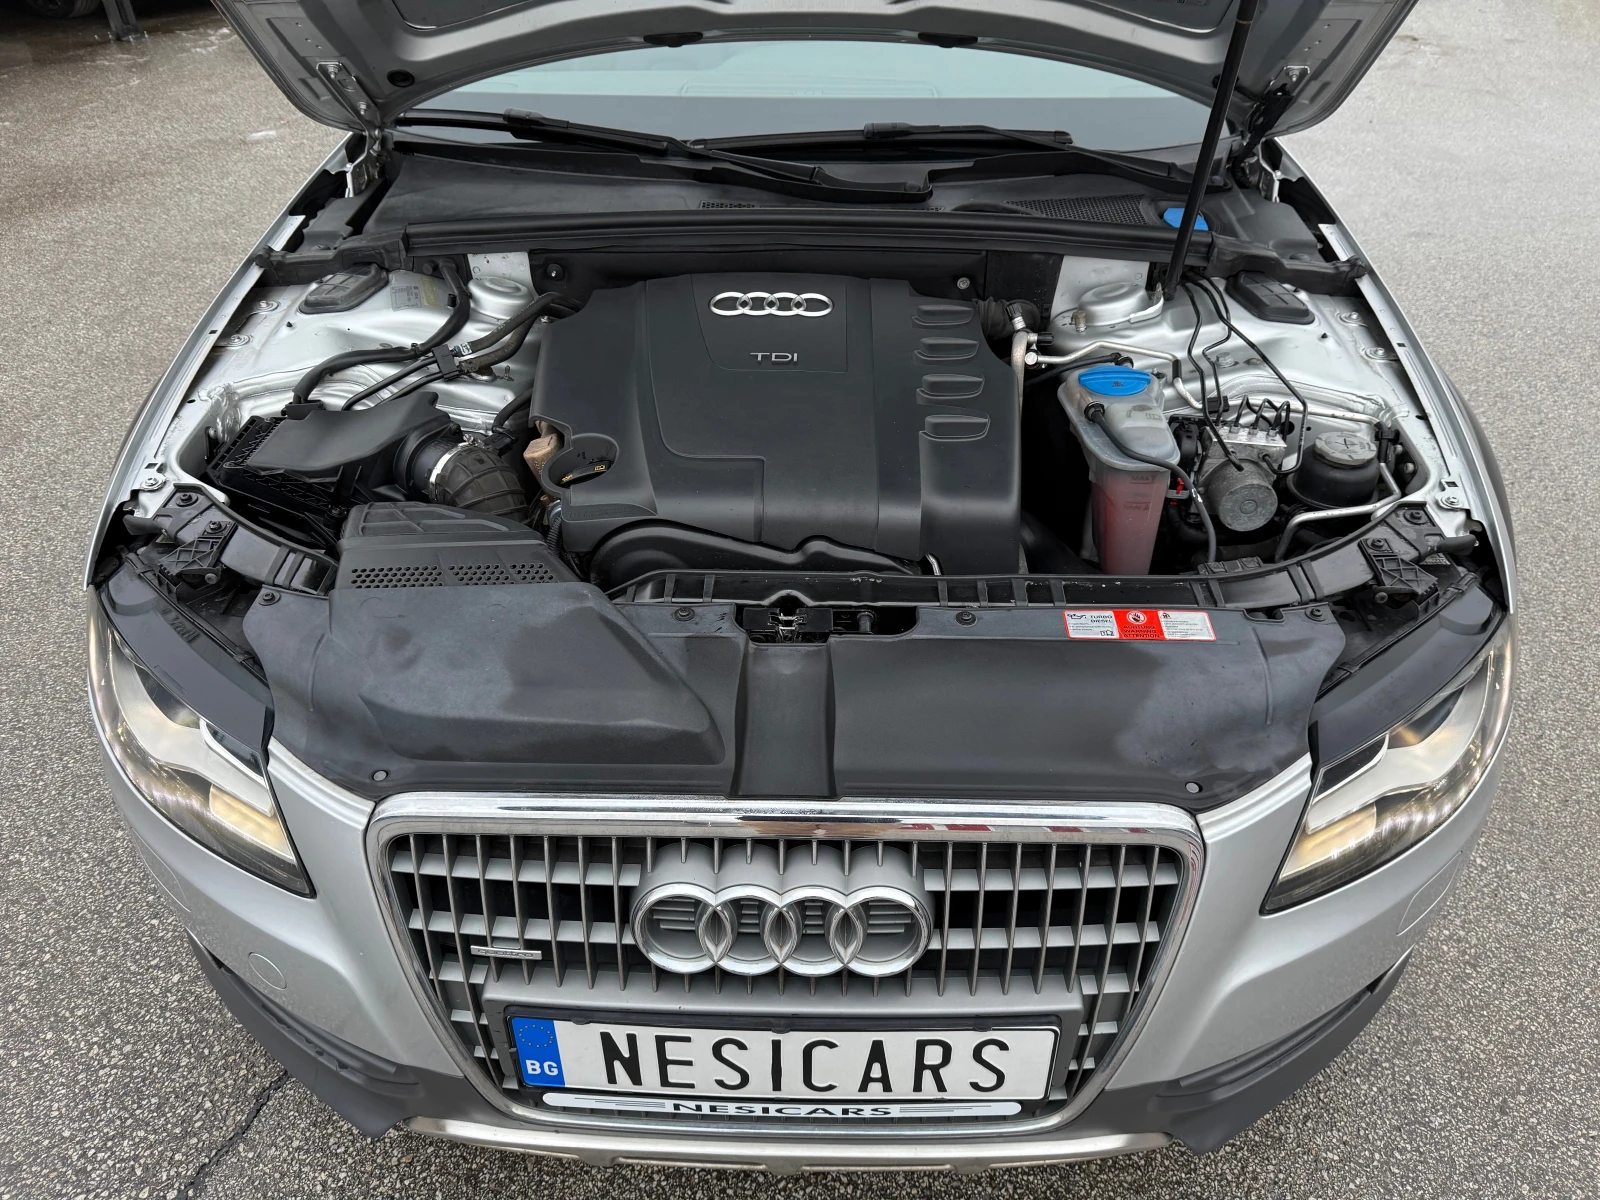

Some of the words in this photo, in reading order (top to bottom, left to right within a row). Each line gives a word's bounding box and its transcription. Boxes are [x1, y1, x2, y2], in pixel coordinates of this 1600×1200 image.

[750, 352, 798, 362] TDI
[525, 1060, 559, 1076] BG
[600, 1031, 1009, 1093] NESICARS
[672, 1102, 892, 1117] NESICARS
